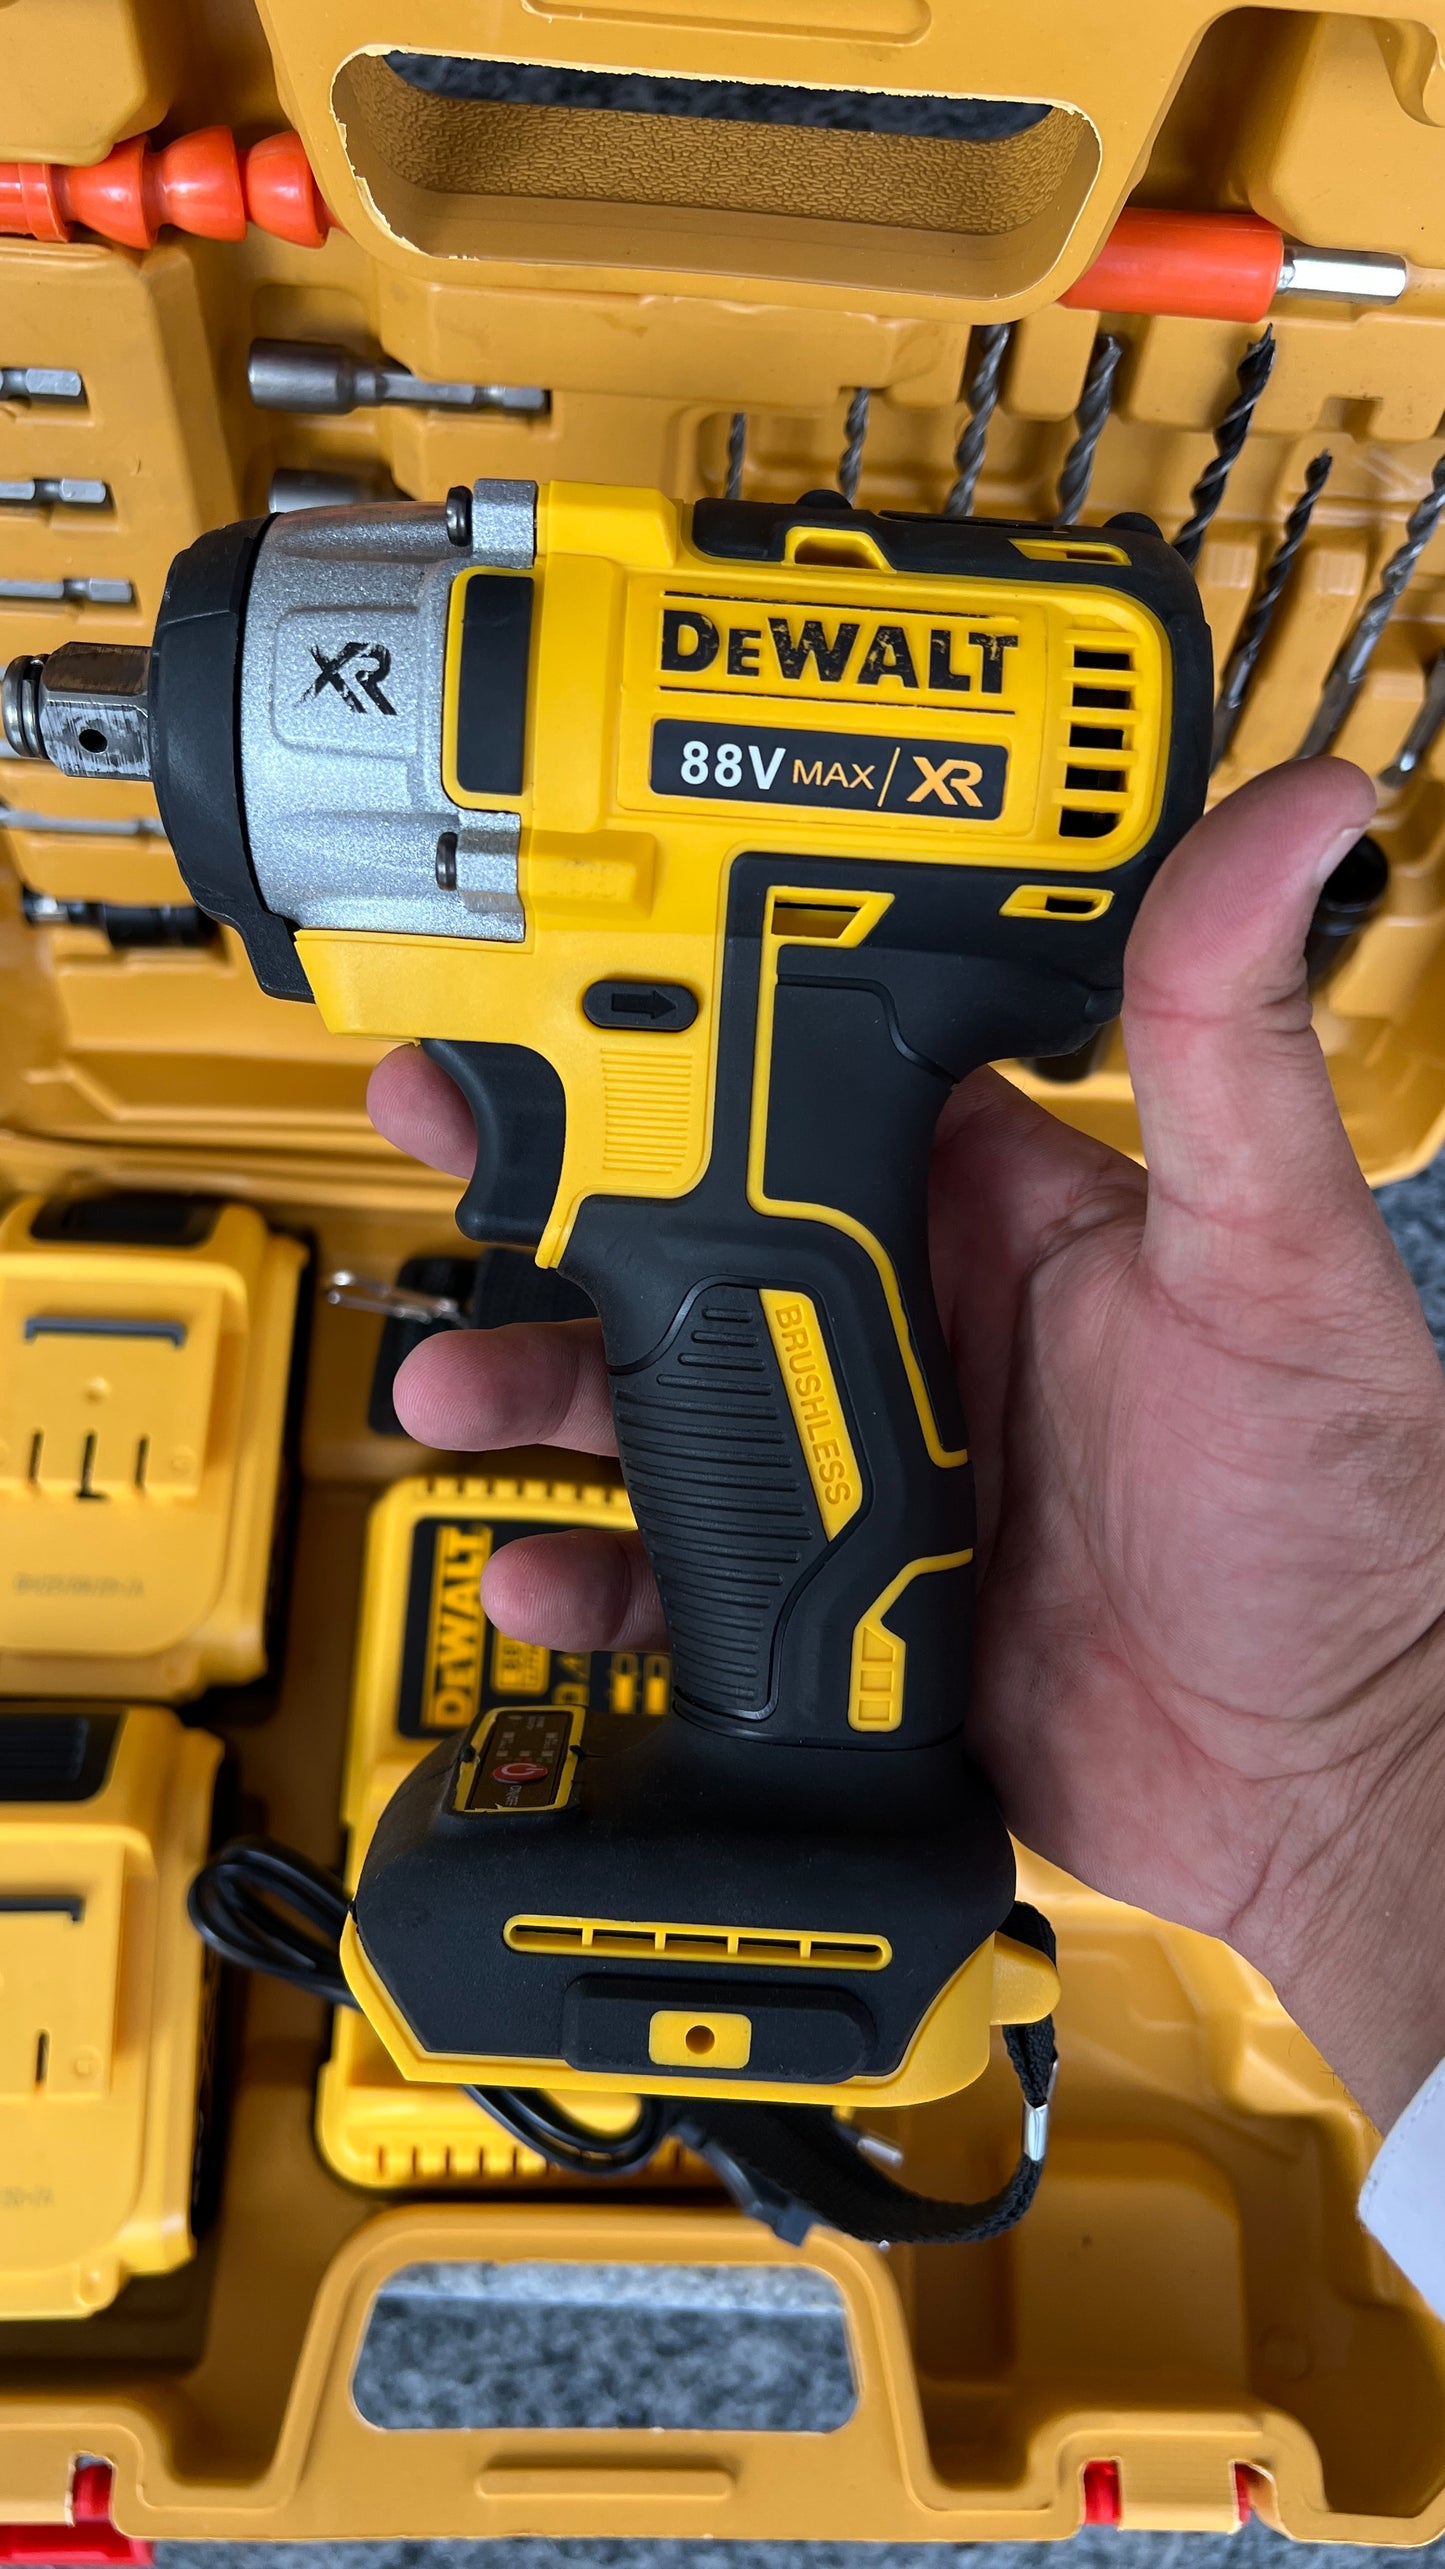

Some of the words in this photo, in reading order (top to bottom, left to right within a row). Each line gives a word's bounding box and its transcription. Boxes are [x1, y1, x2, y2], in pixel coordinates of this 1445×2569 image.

[293, 641, 398, 717] XR
[680, 740, 787, 791] 88V
[792, 758, 876, 791] MAX
[906, 755, 984, 808] XR
[774, 1302, 852, 1505] BRUSHLESS
